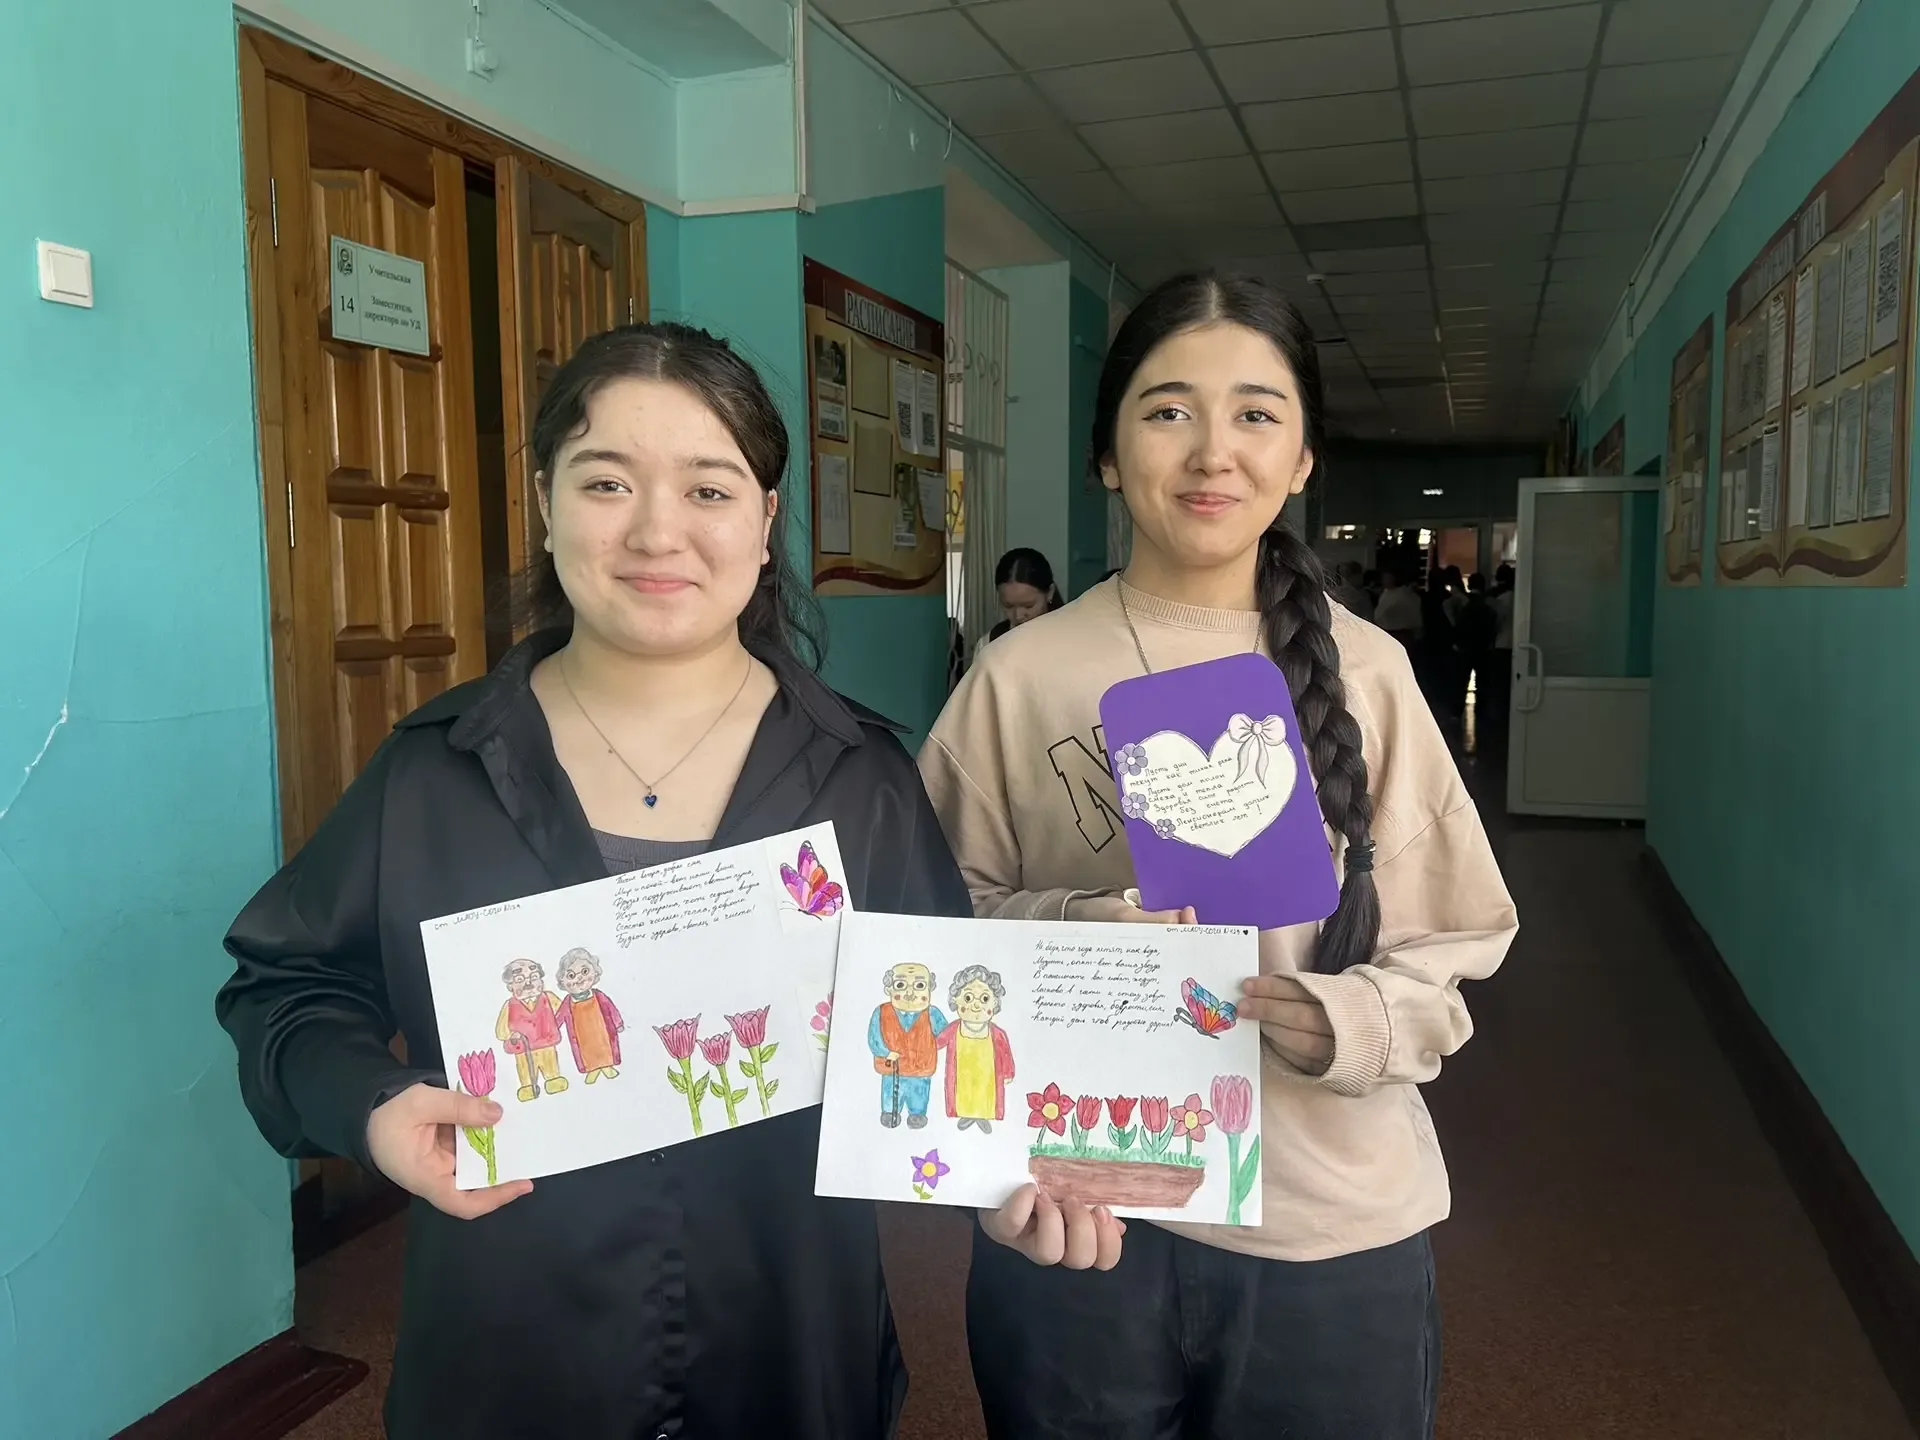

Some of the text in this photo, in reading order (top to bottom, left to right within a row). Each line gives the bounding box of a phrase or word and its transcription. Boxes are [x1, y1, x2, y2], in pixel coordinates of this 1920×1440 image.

[368, 264, 412, 285] Учительская
[340, 295, 355, 313] 14
[371, 295, 413, 313] Заместитель
[364, 312, 399, 326] директора
[847, 292, 915, 350] РАСПИСАНИЕ
[1166, 773, 1182, 781] как
